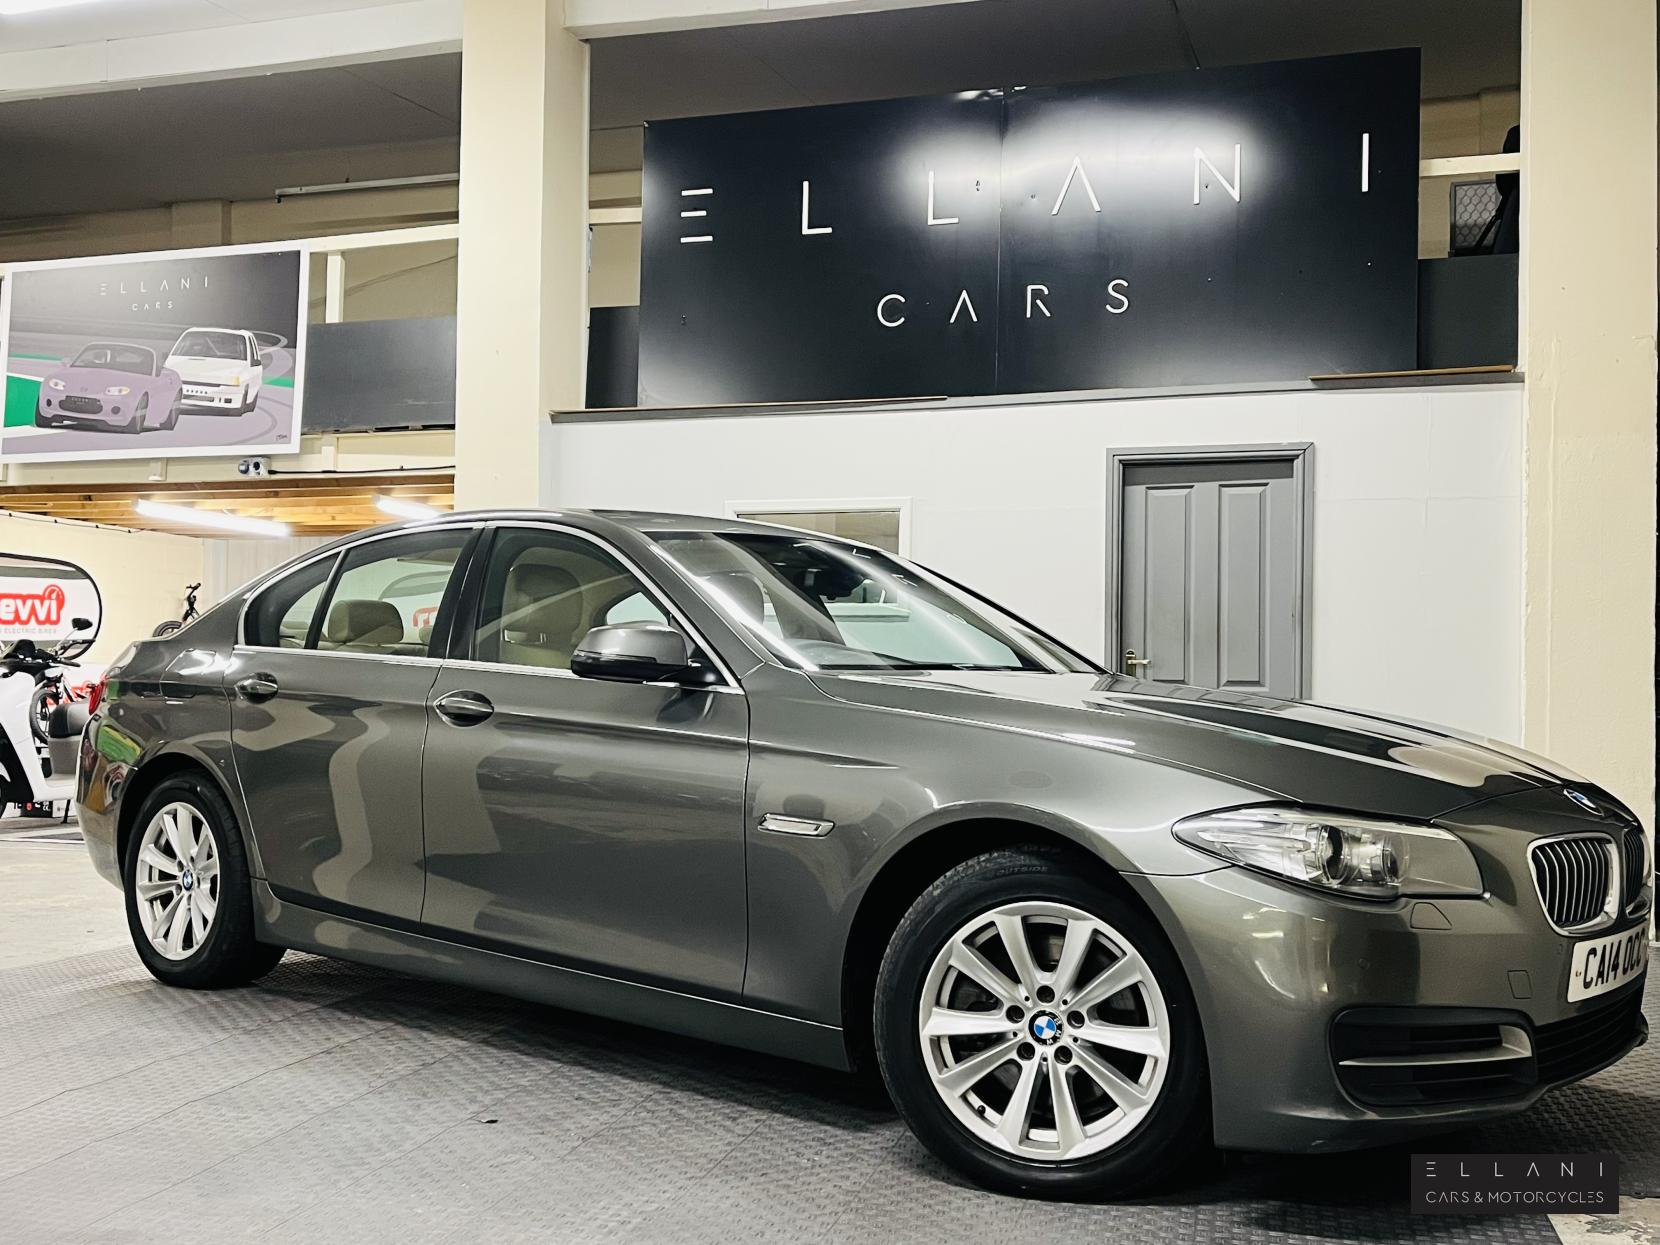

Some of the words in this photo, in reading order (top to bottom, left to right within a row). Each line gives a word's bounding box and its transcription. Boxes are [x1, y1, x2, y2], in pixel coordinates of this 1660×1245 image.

[680, 132, 1370, 243] ELLANI
[100, 276, 208, 296] ELLANI
[876, 279, 1130, 328] CARS
[1583, 940, 1622, 989] CA14
